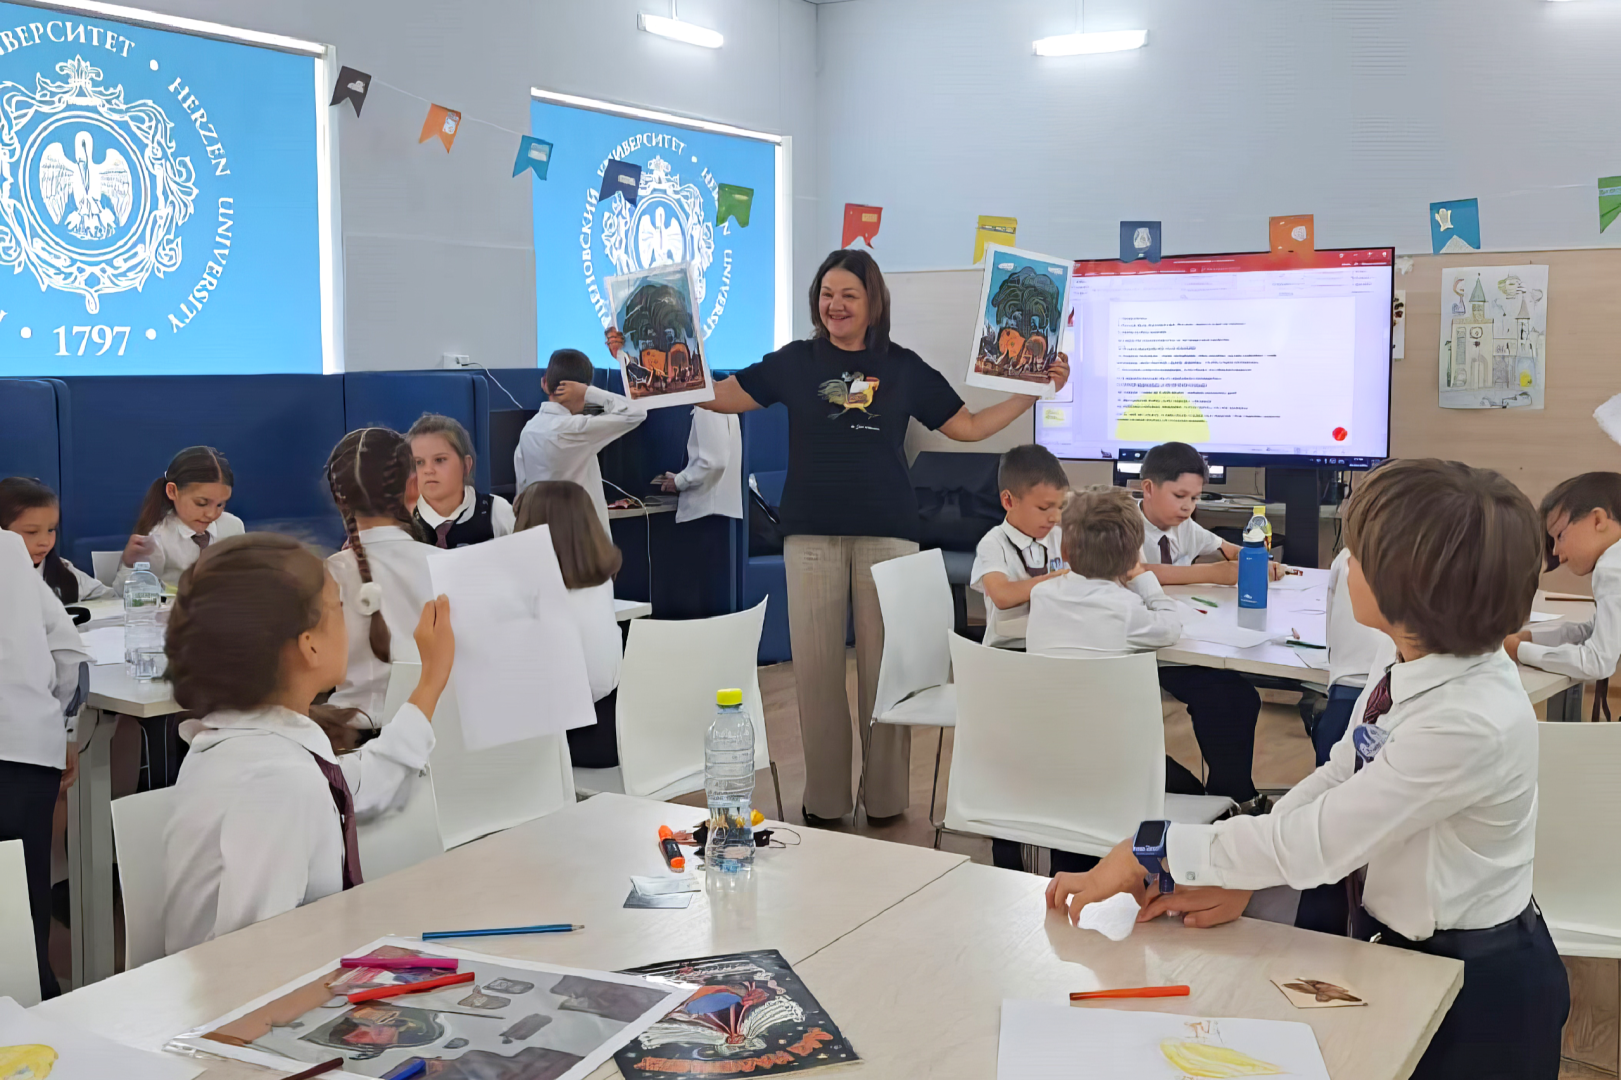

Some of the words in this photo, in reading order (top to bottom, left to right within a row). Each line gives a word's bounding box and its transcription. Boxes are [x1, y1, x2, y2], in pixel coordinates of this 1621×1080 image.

[0, 20, 136, 58] ВЕРСИТЕТ
[167, 77, 231, 178] HERZEN
[167, 197, 235, 334] UNIVERSITY
[52, 324, 132, 357] 1797
